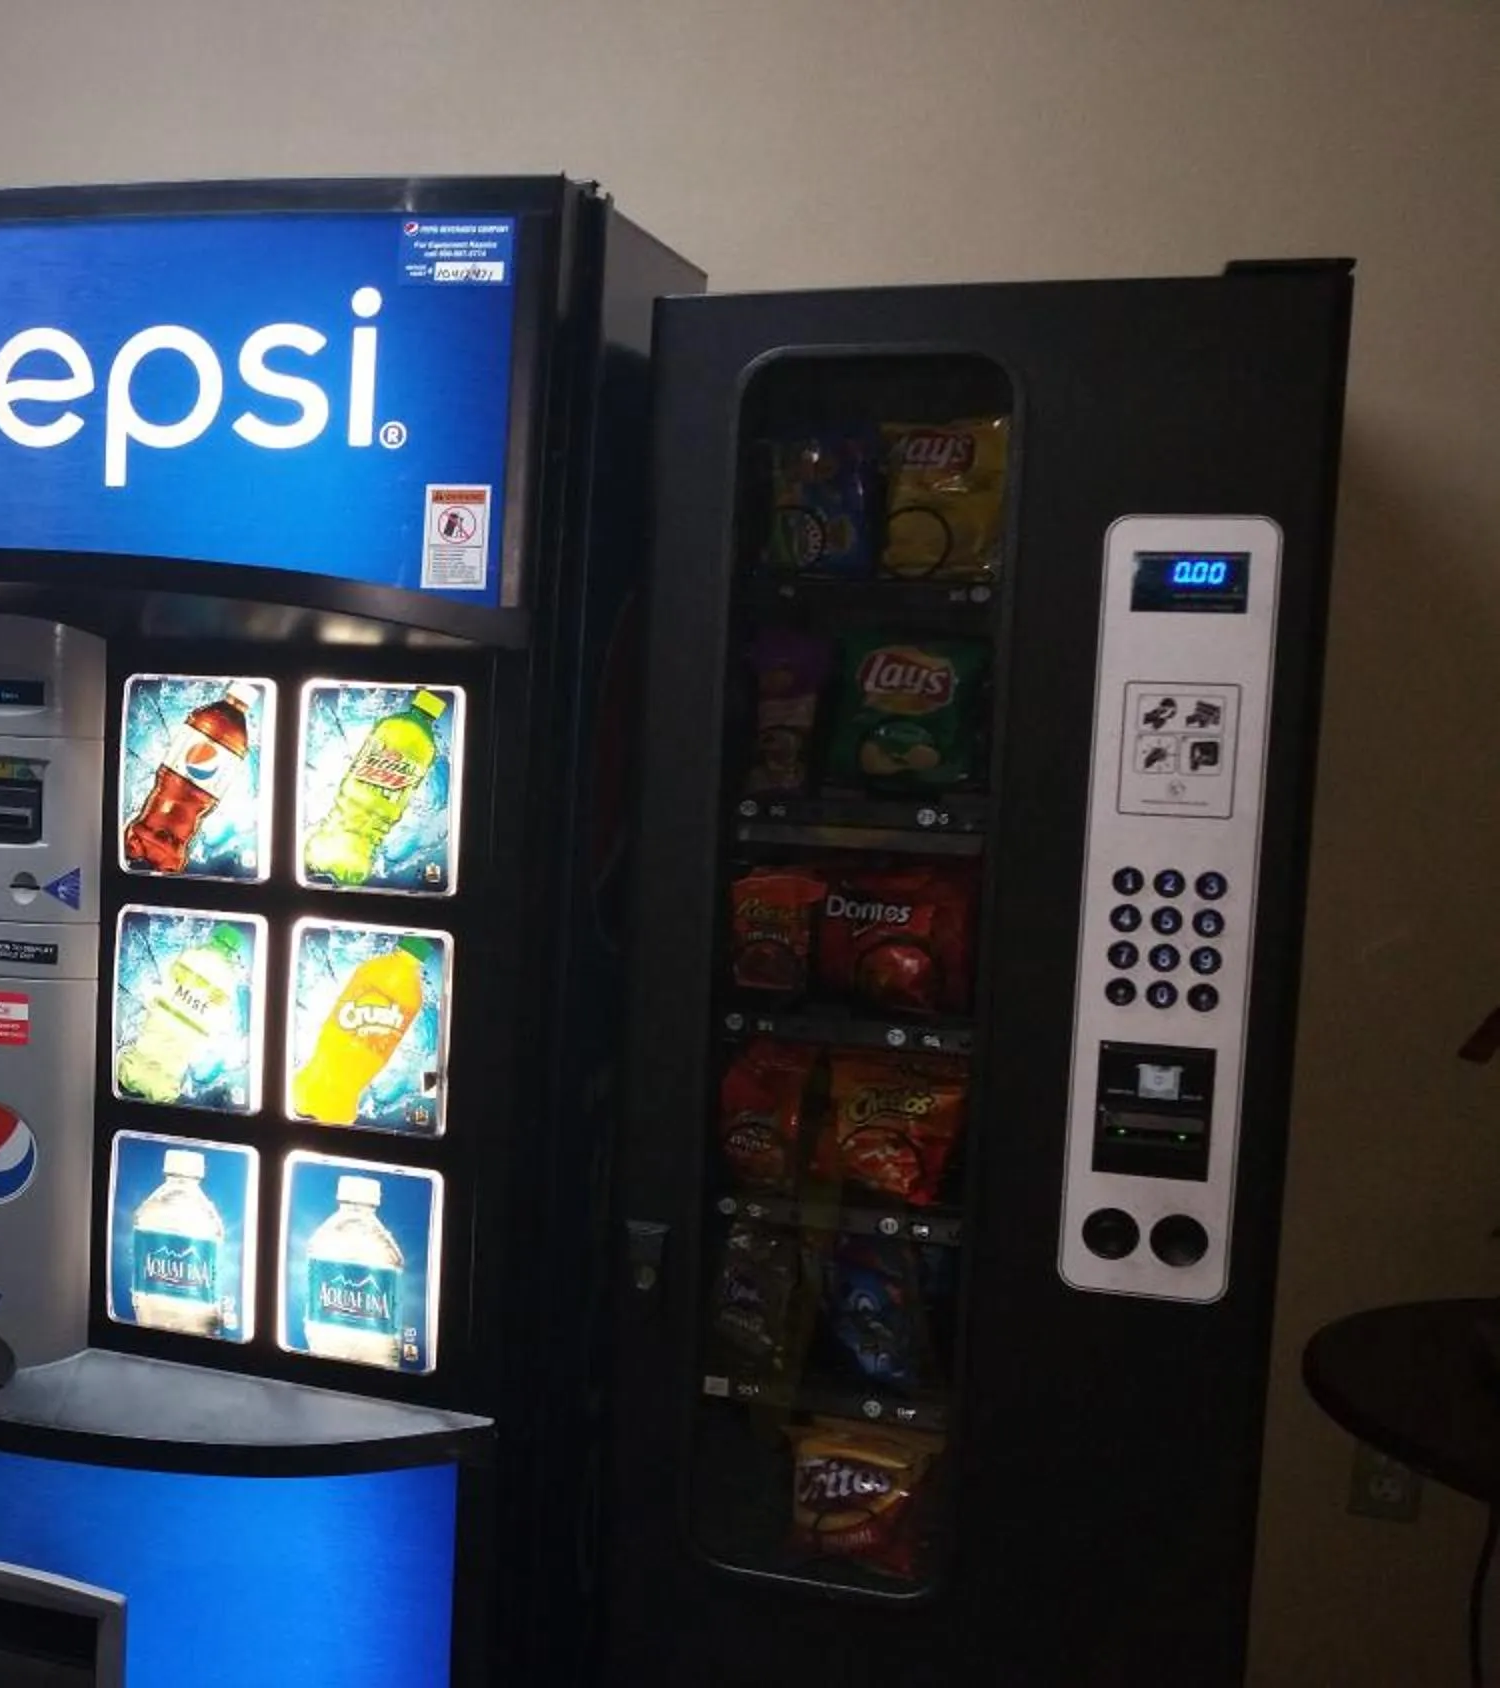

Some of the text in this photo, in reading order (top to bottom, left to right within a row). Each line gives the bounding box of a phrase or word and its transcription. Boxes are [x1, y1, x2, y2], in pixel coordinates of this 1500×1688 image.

[1172, 561, 1227, 584] 0.00
[1123, 873, 1133, 889] 1
[1163, 875, 1175, 892] 2
[1204, 877, 1218, 894] 3
[1118, 909, 1131, 926] 4
[1160, 912, 1173, 929] 5
[1201, 915, 1215, 932] 6
[1118, 947, 1129, 963] 7
[1157, 950, 1170, 967] 8
[1201, 952, 1213, 969] 9
[1156, 987, 1168, 1003] 0
[339, 1000, 404, 1030] Crush
